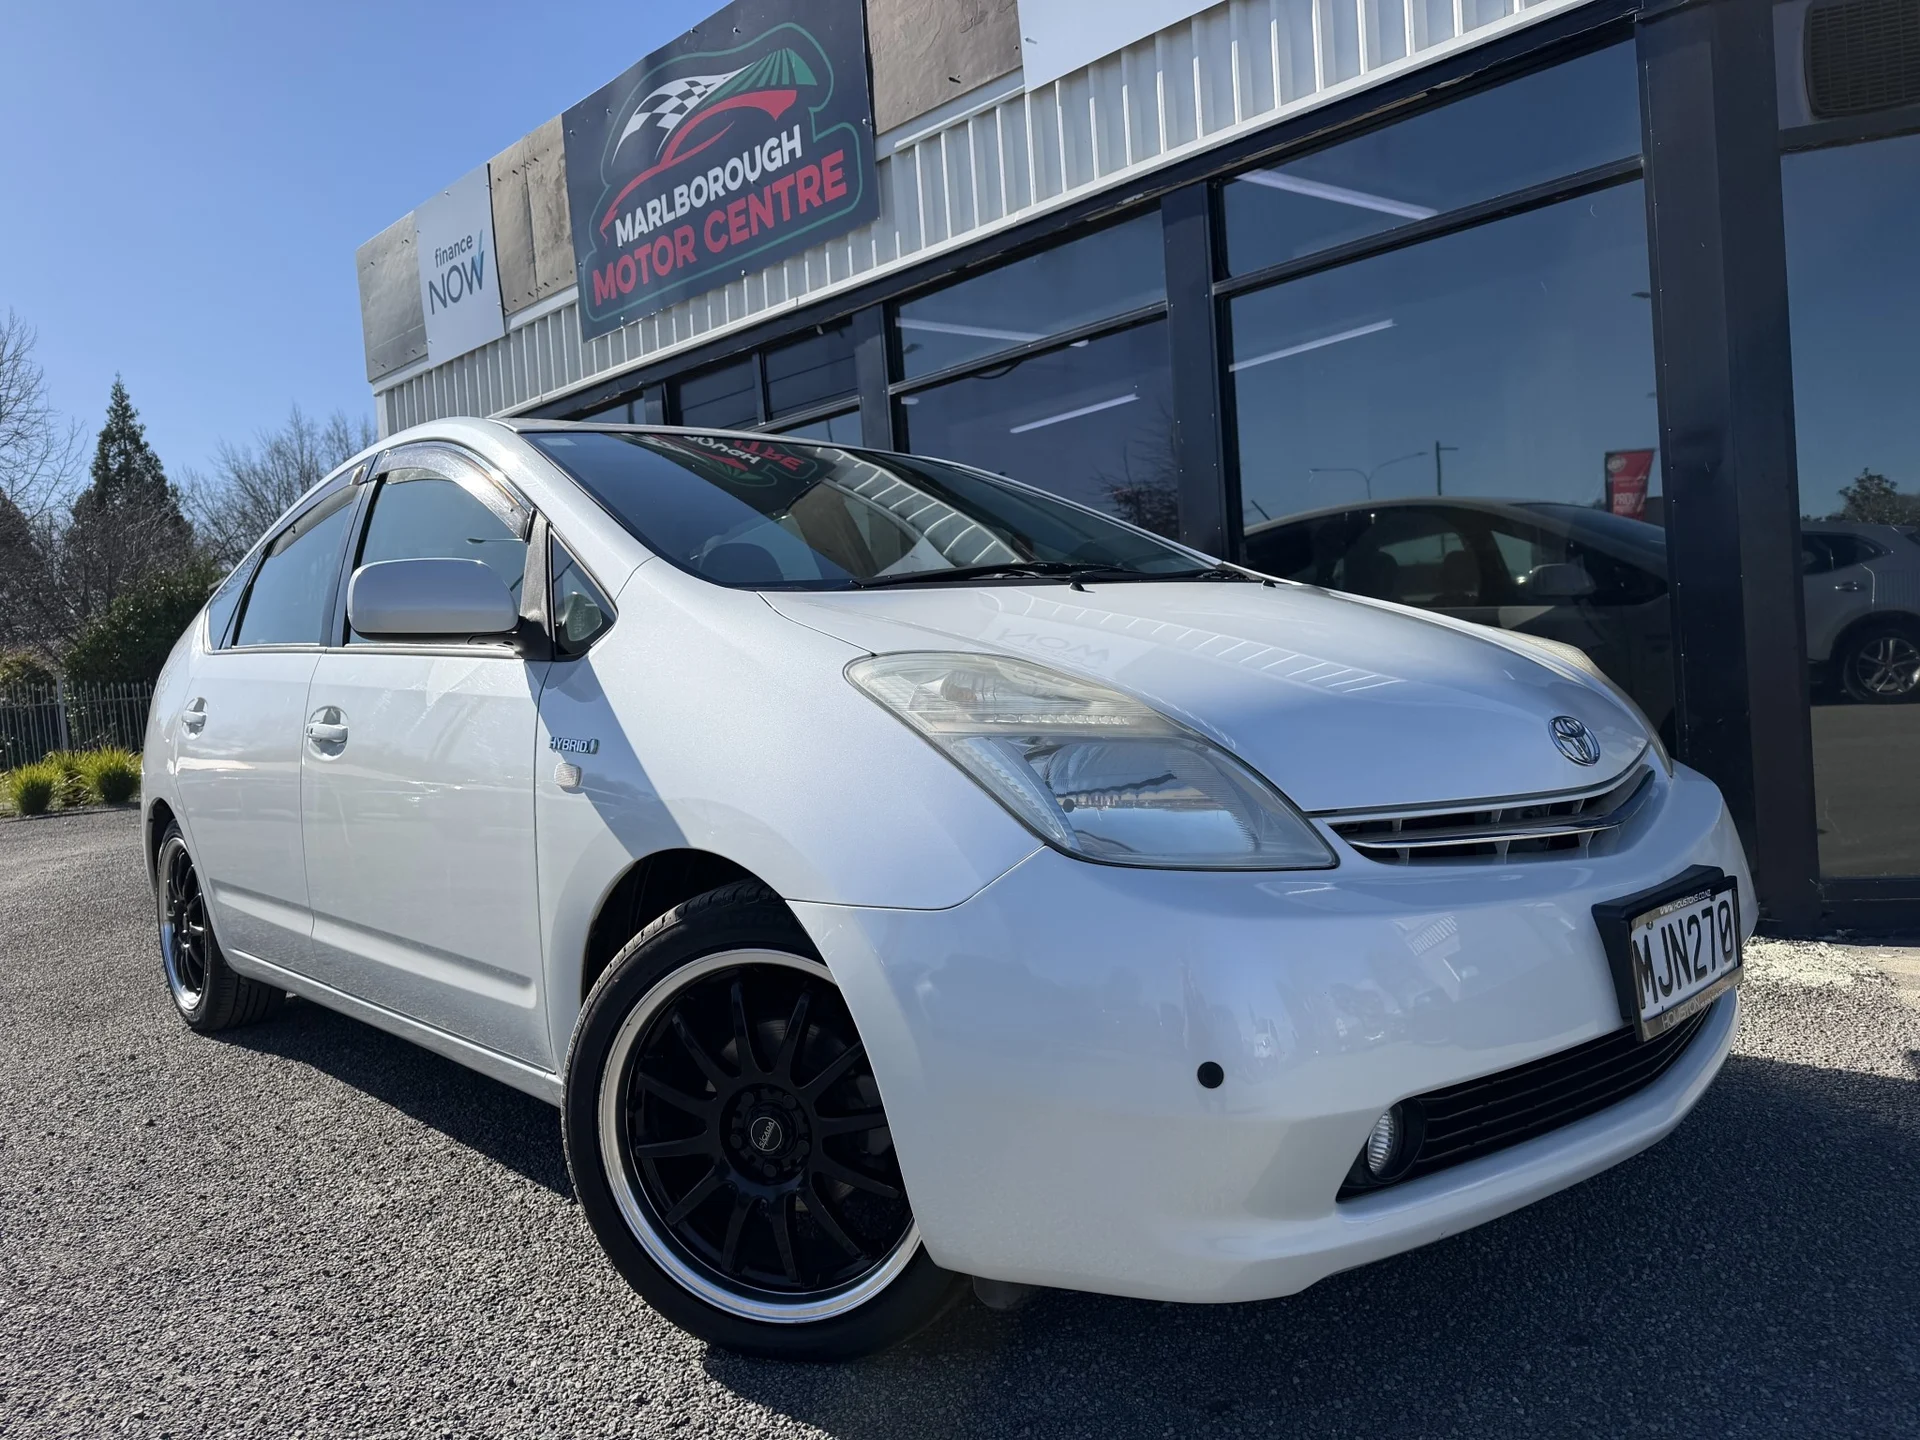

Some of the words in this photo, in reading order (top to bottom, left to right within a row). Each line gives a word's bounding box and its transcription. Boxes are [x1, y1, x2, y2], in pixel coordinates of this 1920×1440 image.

[592, 227, 697, 306] MOTOR
[704, 149, 848, 254] CENTRE
[615, 124, 803, 248] MARLBOROUGH
[428, 232, 485, 315] NOW
[434, 233, 474, 269] finance
[1632, 899, 1734, 1010] MJN270
